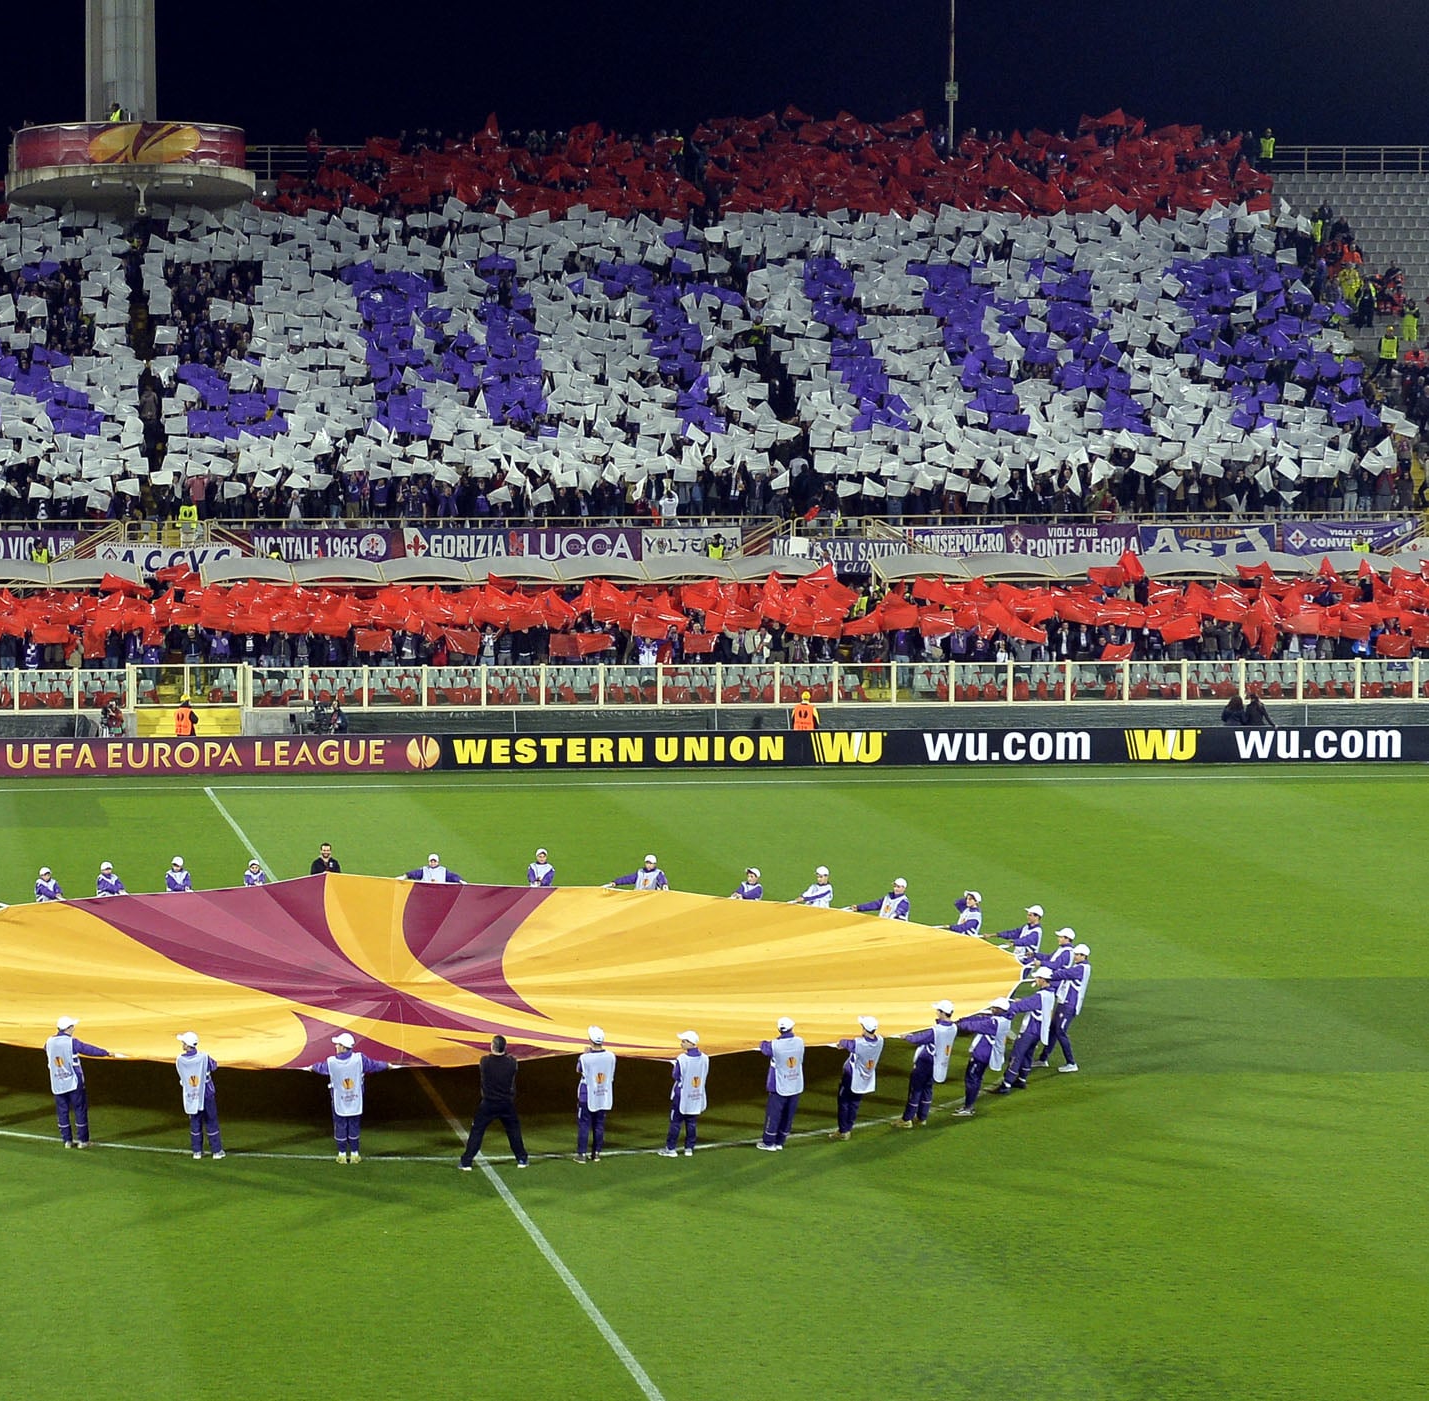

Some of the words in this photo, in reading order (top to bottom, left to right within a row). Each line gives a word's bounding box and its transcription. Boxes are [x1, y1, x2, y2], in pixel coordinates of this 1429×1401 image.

[915, 533, 1004, 552] SANSEPOLCRO
[1047, 527, 1073, 537] VIOLA
[1076, 527, 1098, 537] CLUB
[1178, 530, 1212, 538] VIOLA
[7, 537, 56, 560] VIOA
[254, 537, 319, 558] MONTALE
[325, 537, 358, 557] 1965
[431, 535, 507, 560] GORIZIA
[523, 533, 635, 561] LUCCA
[772, 538, 821, 560] MOTE
[826, 542, 853, 560] SAN
[858, 543, 908, 561] SAVINO
[1026, 539, 1075, 558] PONTE
[1079, 540, 1089, 554] A
[844, 562, 870, 573] CLU
[6, 743, 97, 769] UEFA
[107, 742, 242, 768] EUROPA
[253, 740, 385, 766] LEAGUE
[453, 737, 644, 764] WESTERN
[655, 736, 784, 762] UNION
[820, 732, 882, 762] WU
[923, 732, 1092, 761] wu.com
[1133, 730, 1195, 760] WU
[1235, 729, 1402, 759] wu.com
